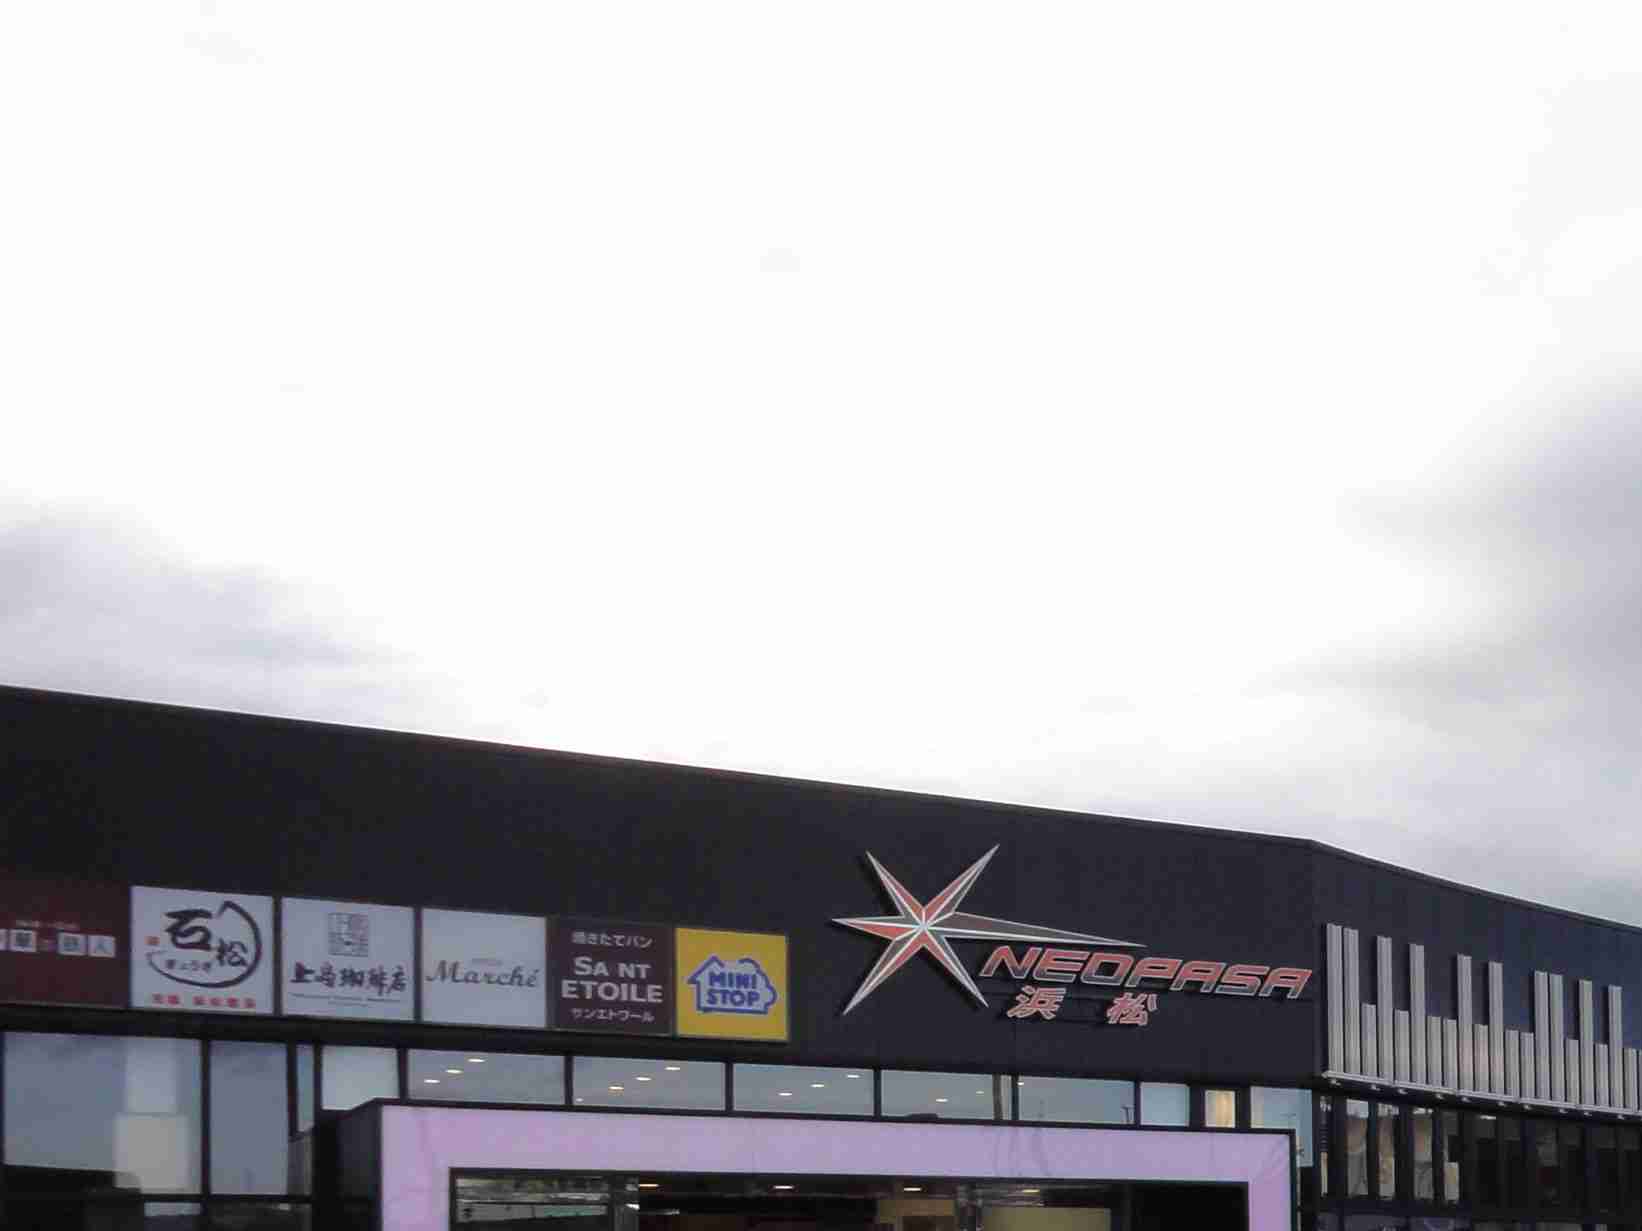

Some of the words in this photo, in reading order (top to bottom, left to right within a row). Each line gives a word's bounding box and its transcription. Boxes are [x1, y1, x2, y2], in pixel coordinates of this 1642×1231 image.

[425, 959, 540, 988] Marché
[708, 971, 758, 990] MINI
[979, 945, 1313, 1000] NEOPASA
[561, 979, 664, 1004] ETOILE
[707, 988, 761, 1008] STOP
